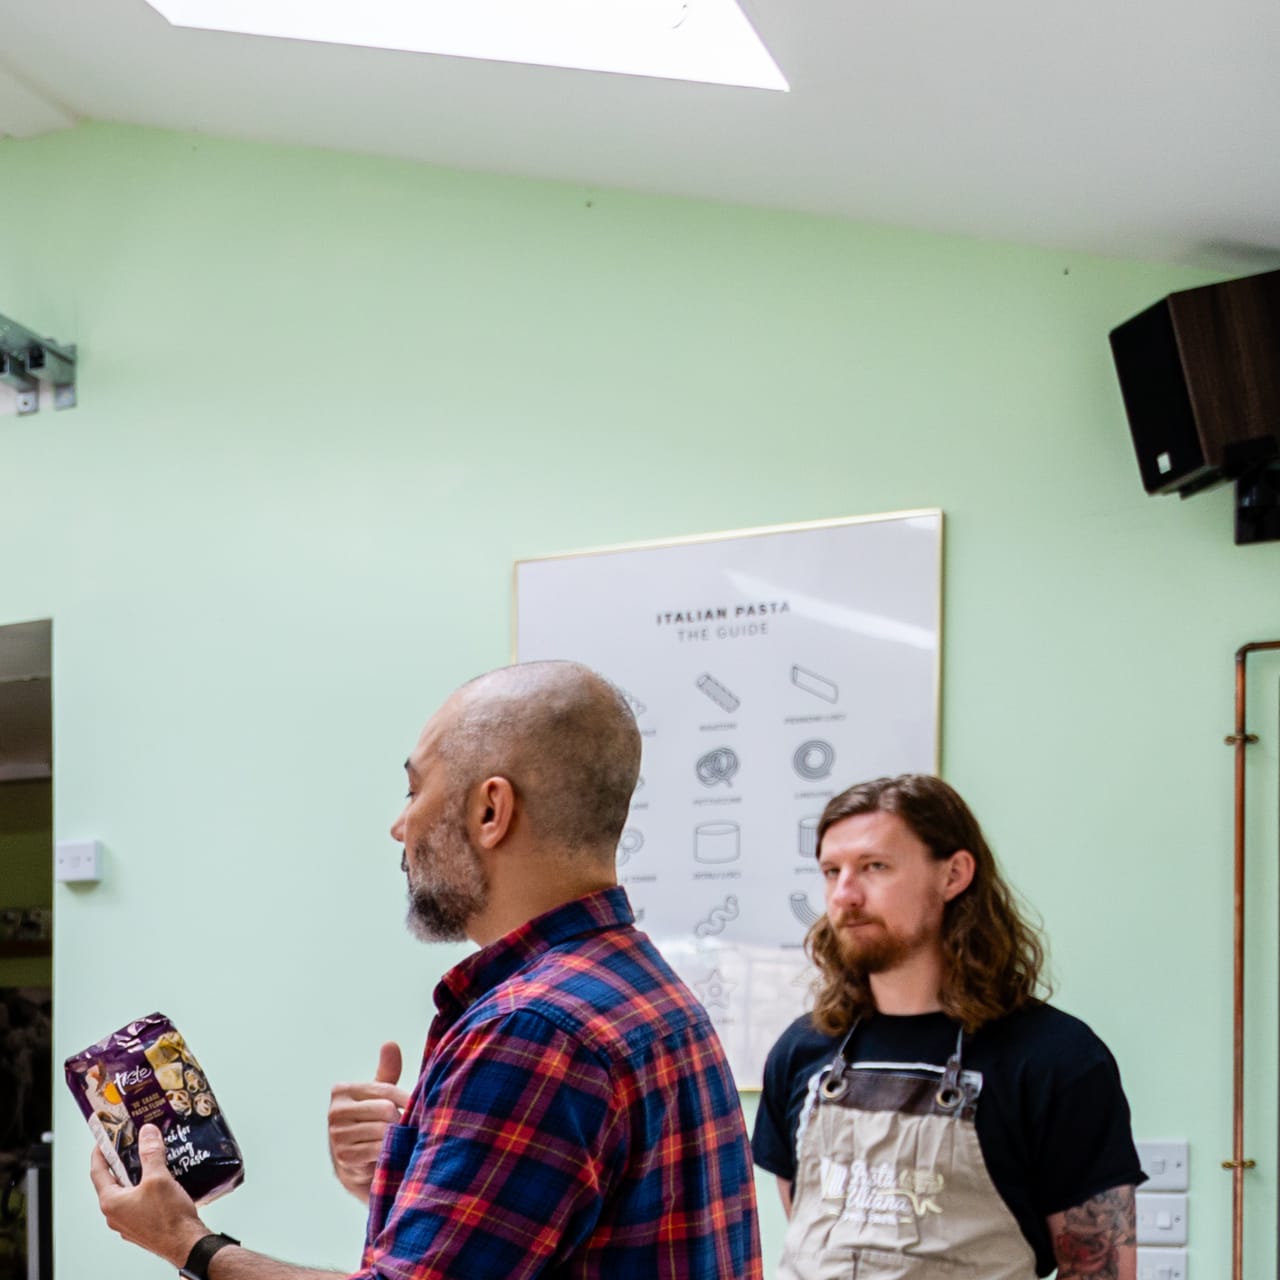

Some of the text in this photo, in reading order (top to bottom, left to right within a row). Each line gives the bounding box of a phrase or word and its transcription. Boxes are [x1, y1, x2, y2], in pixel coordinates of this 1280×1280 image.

[656, 601, 791, 626] ITALIAN PASTA
[677, 622, 769, 642] THE GUIDE
[167, 1142, 195, 1161] aking
[179, 1150, 211, 1173] Pasta
